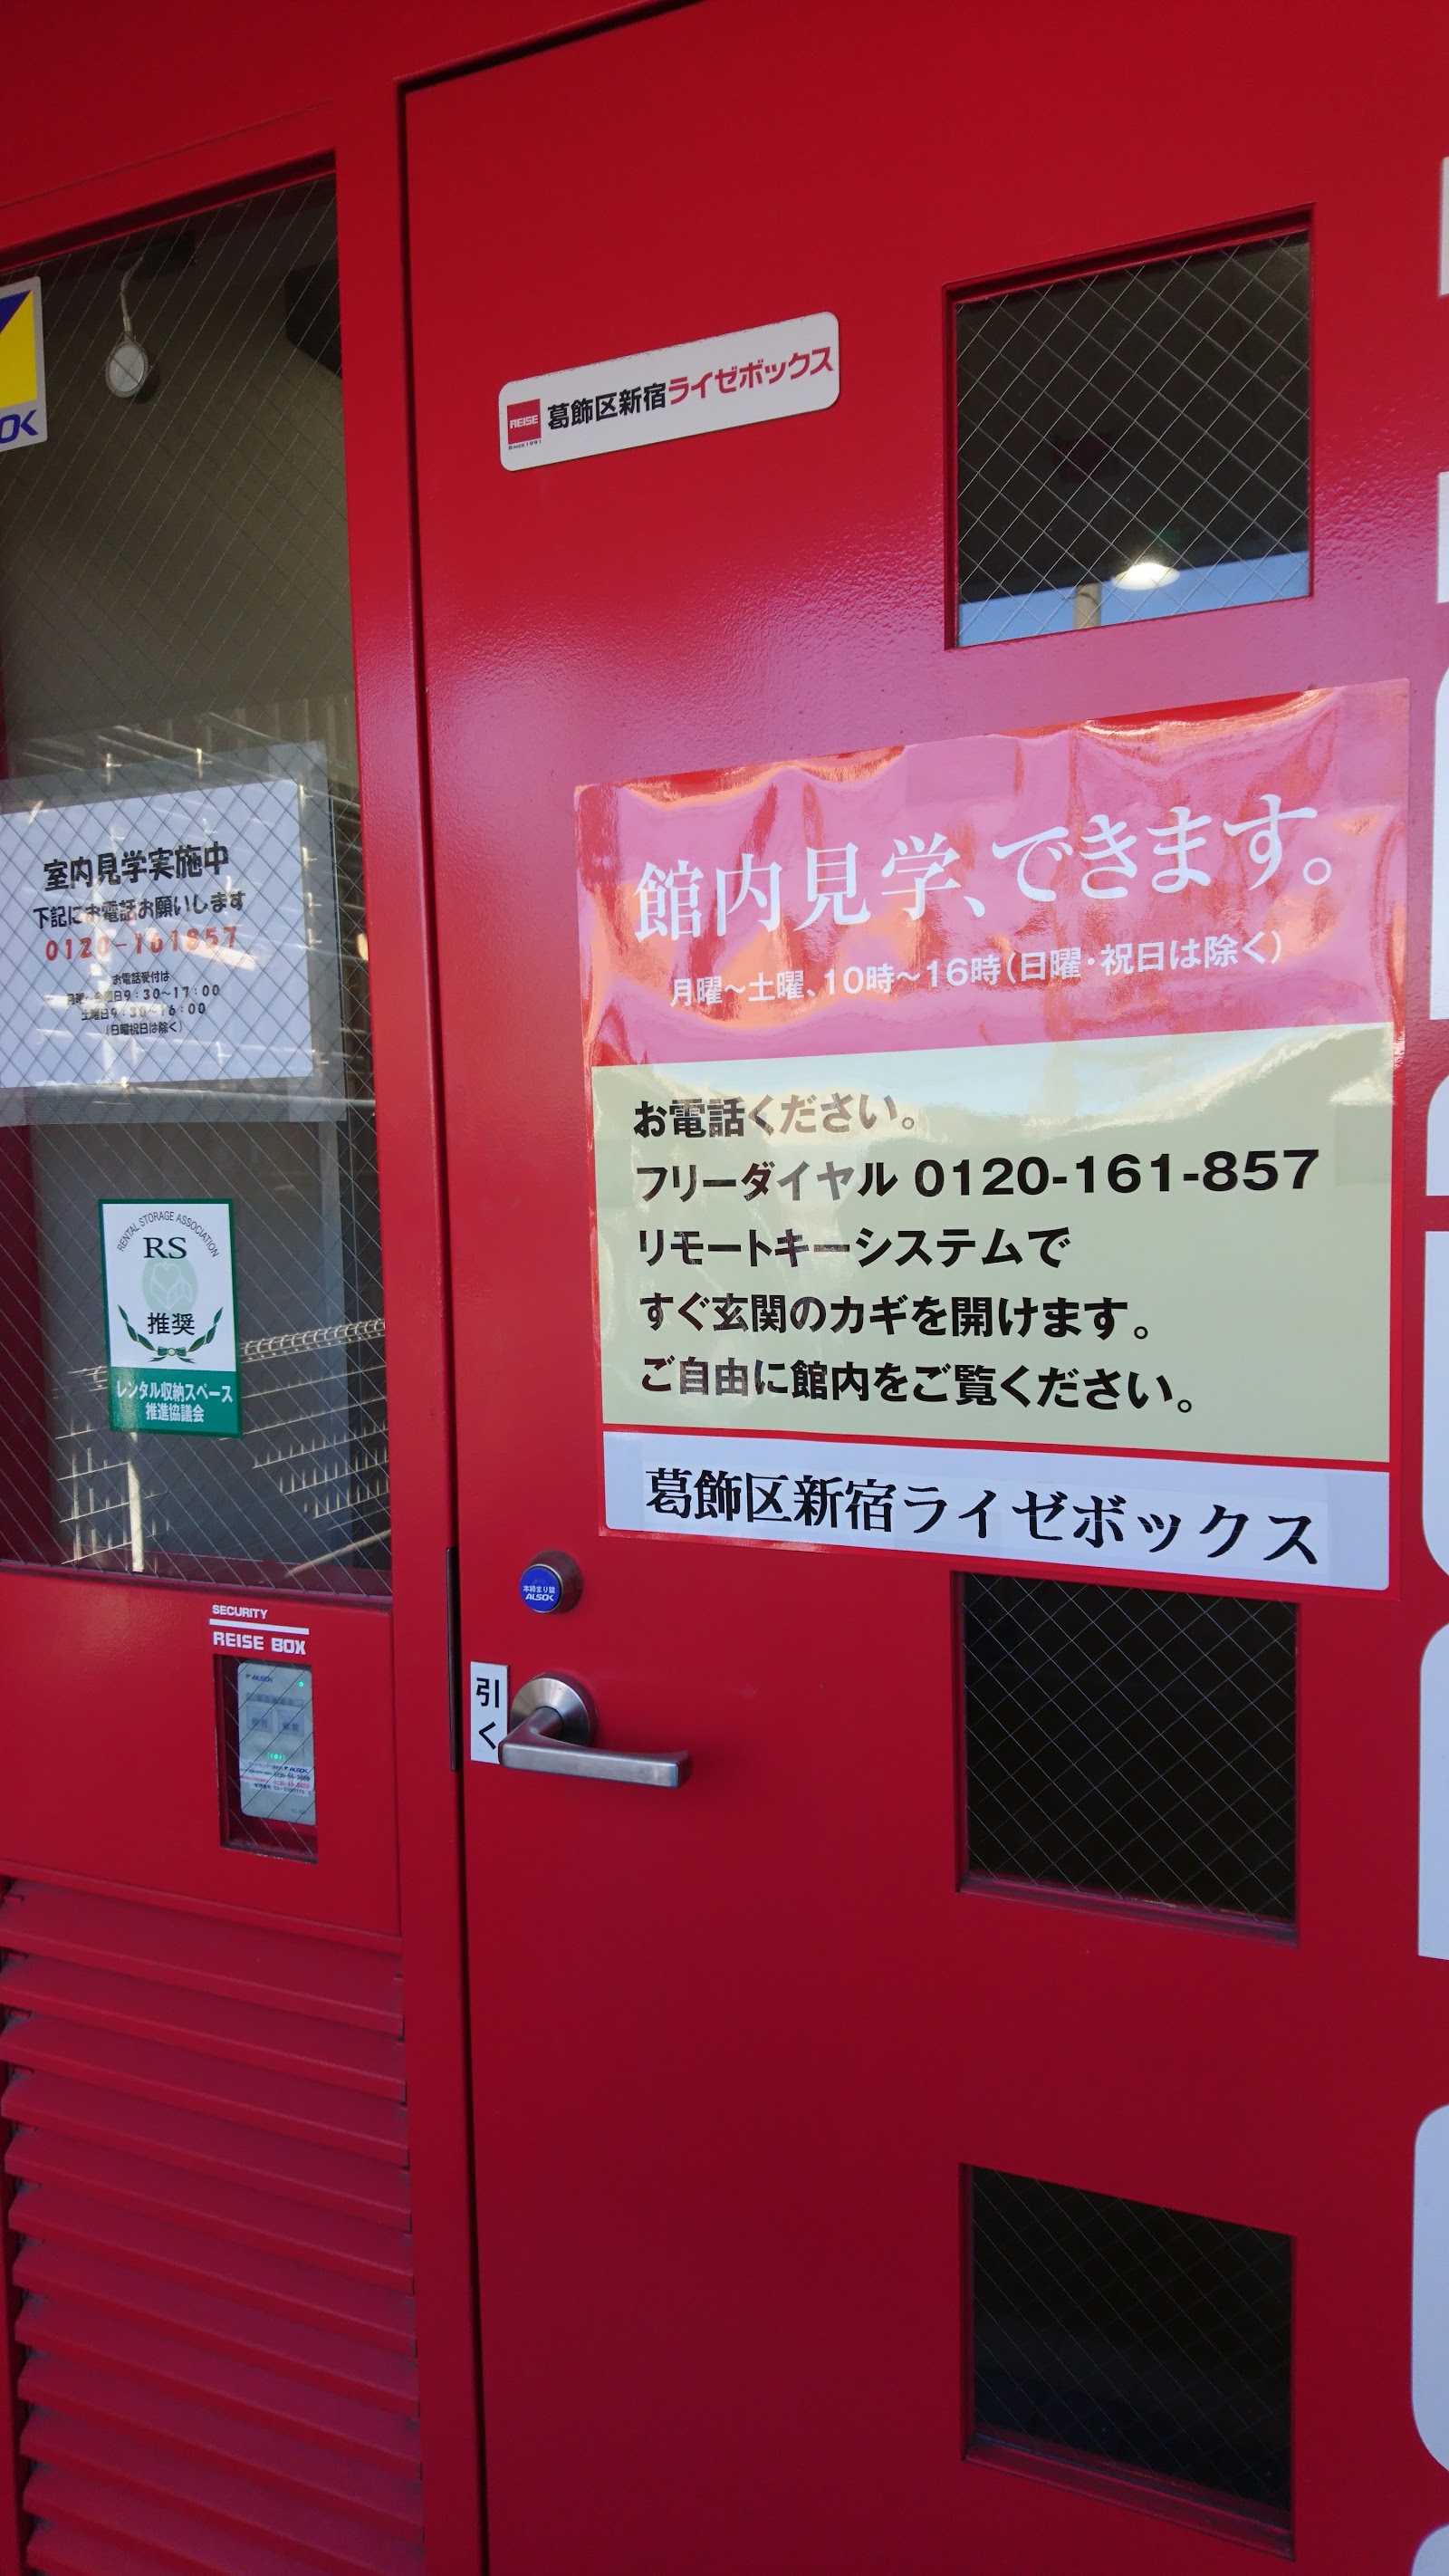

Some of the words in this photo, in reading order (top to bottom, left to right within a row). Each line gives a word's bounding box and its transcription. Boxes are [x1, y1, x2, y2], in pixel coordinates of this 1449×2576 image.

[548, 346, 834, 429] 葛飾区新宿ライゼボックス
[510, 414, 539, 429] REISE
[43, 841, 229, 892] 室内見学実施中
[633, 793, 1333, 944] 館内見学、できます。
[33, 890, 246, 929] 下記にお電話お願いします
[112, 970, 170, 985] お電話受付は
[632, 1093, 916, 1139] お電話ください。
[636, 1159, 897, 1203] フリーダイヤル
[914, 1149, 1320, 1197] 0120-161-857
[117, 1223, 140, 1253] RENTAL
[139, 1210, 175, 1227] STORAGE
[176, 1214, 220, 1258] ASSOCIATION
[142, 1236, 187, 1259] RS
[638, 1226, 1071, 1270] リモートキーシステムで
[148, 1312, 196, 1336] 推奨
[639, 1293, 1150, 1341] すぐ玄関のカギを開けます。
[116, 1379, 234, 1404] レンタル収納スペース
[640, 1355, 1193, 1413] ご自由に館内をご覧ください。
[145, 1401, 205, 1423] 推進協議会
[646, 1466, 1319, 1566] 葛飾区新宿ライゼボックス
[212, 1604, 268, 1620] SECURITY
[525, 1593, 554, 1601] ALSOK
[213, 1630, 264, 1651] REISE
[271, 1637, 307, 1656] BOX
[475, 1677, 501, 1750] 引く
